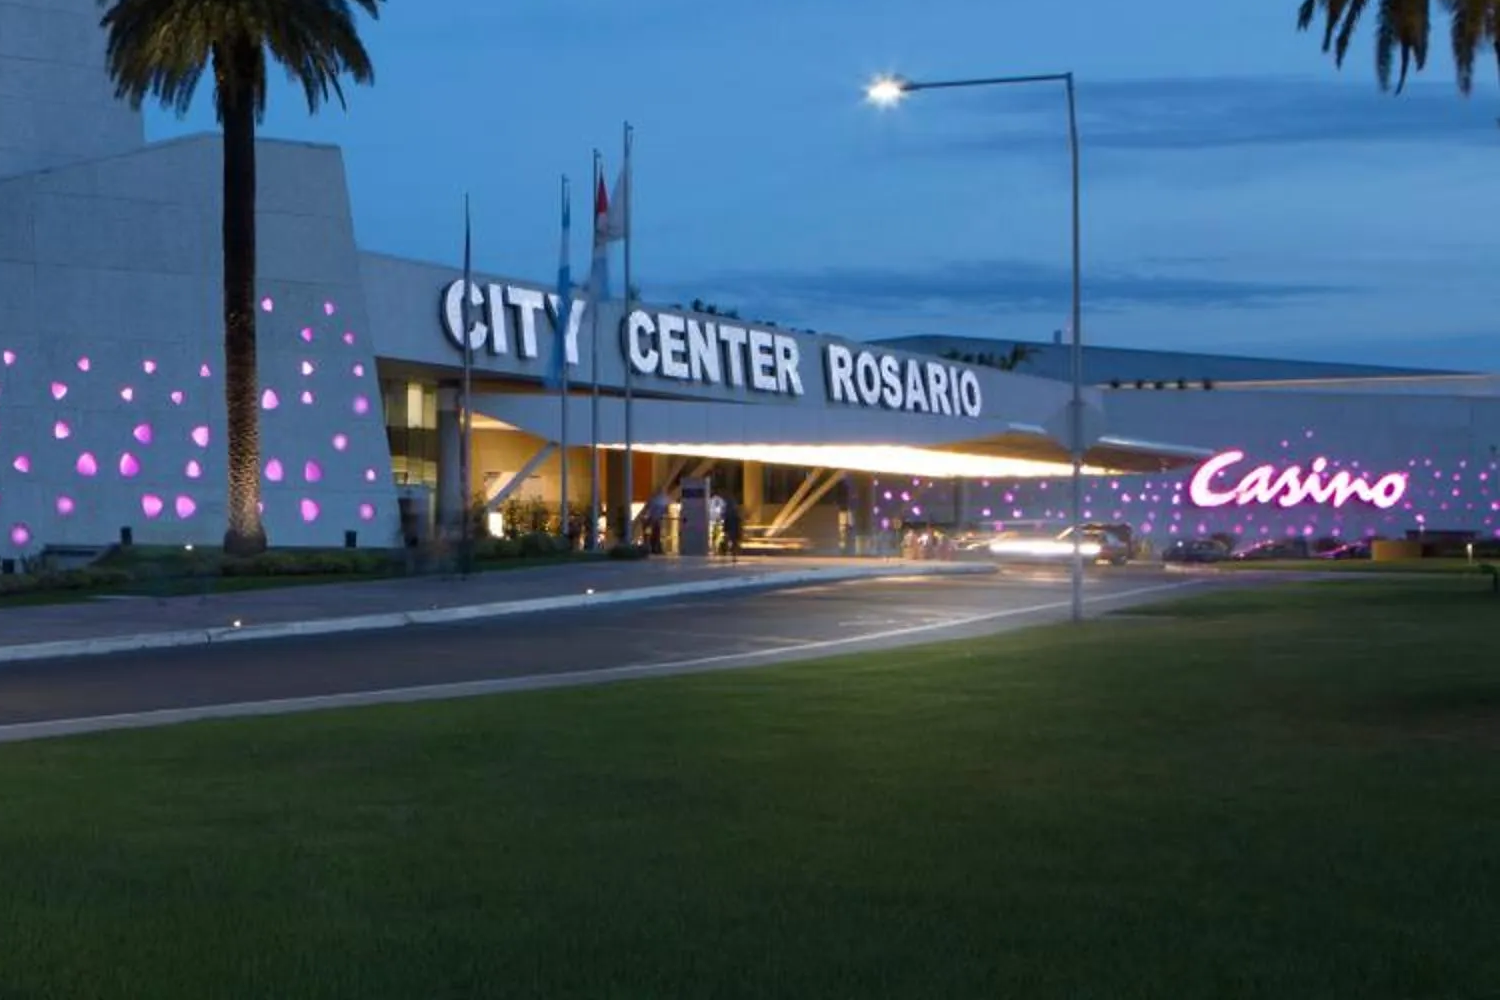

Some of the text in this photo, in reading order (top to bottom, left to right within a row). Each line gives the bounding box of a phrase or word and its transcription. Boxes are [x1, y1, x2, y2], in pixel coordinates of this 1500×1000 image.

[442, 278, 983, 418] CITY CENTER ROSARIO
[1189, 449, 1408, 508] Casino
